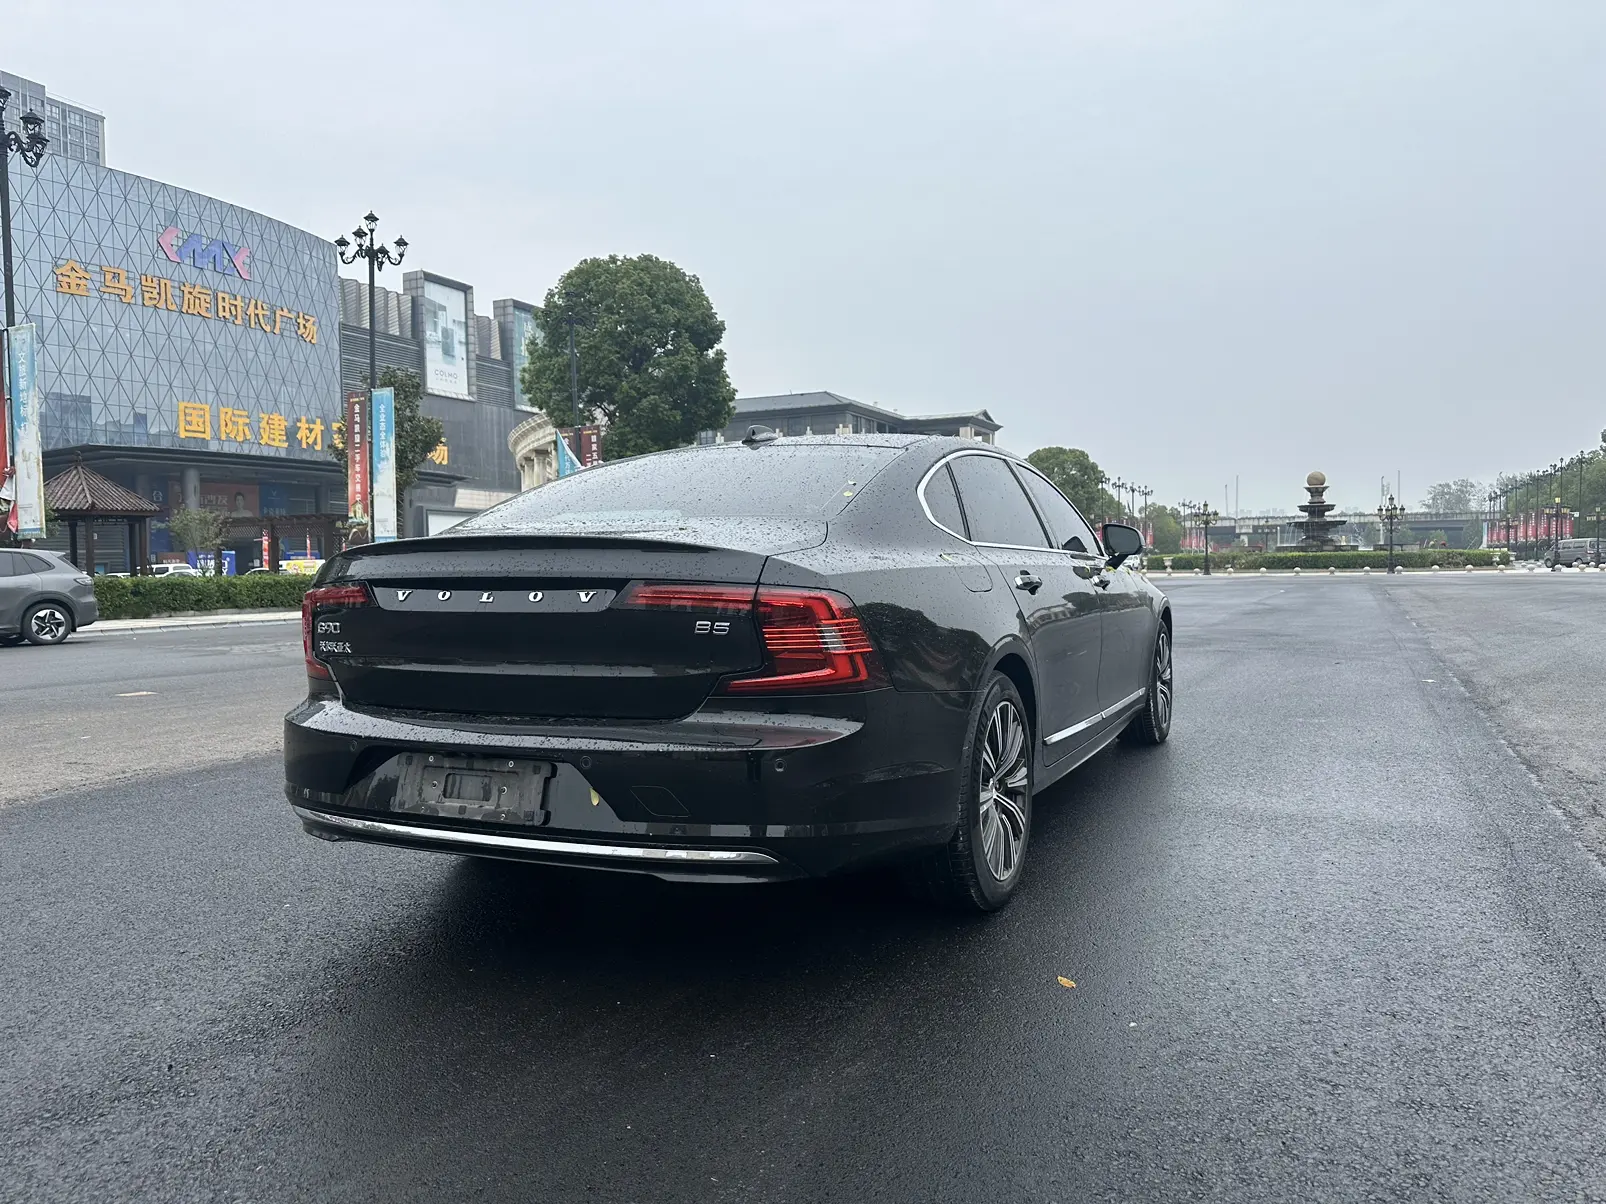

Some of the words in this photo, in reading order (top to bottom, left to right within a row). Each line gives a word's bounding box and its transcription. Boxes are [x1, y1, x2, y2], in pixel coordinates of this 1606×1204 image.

[53, 259, 317, 344] 金马凯旋时代广场
[434, 369, 458, 379] COLMO
[694, 621, 730, 635] B5
